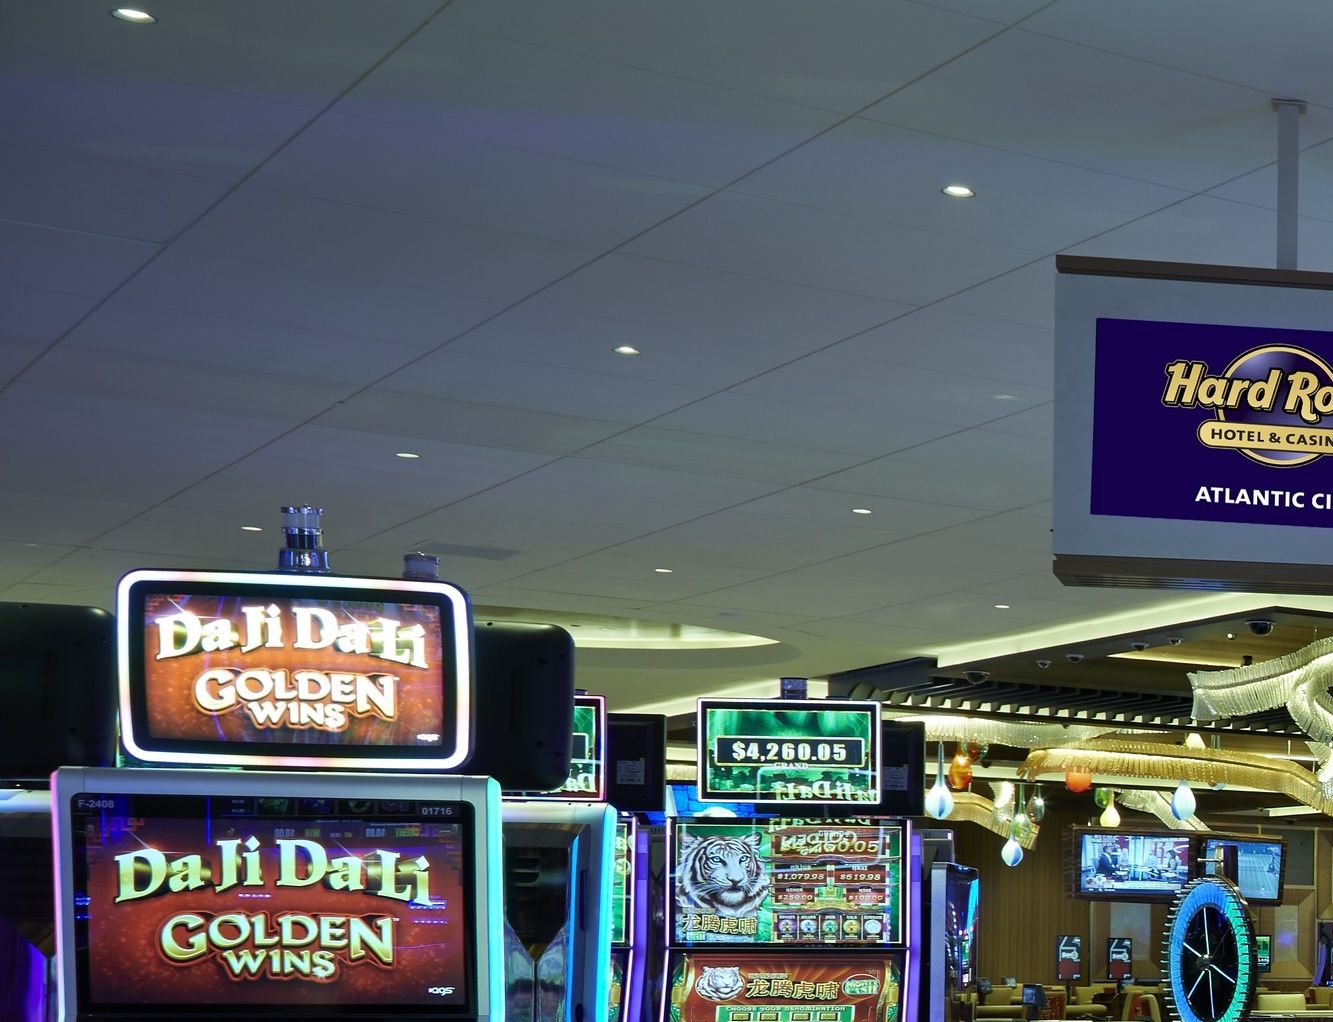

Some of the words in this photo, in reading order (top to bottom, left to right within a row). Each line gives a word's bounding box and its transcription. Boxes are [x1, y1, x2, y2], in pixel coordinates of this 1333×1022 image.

[1163, 360, 1283, 410] Hard
[1211, 428, 1265, 443] HOTEL
[1269, 432, 1281, 444] &
[1195, 486, 1305, 509] ATLANTIC
[194, 669, 396, 718] GOLDEN
[248, 701, 346, 729] WINS
[732, 741, 847, 763] $4,260.05
[773, 762, 809, 770] GRAND
[78, 799, 115, 809] F-2408
[422, 807, 453, 816] 01716
[681, 913, 757, 934] 龙腾虎啸
[161, 913, 394, 963] GOLDEN
[223, 949, 336, 979] WINS
[745, 979, 839, 999] 龙腾虎啸
